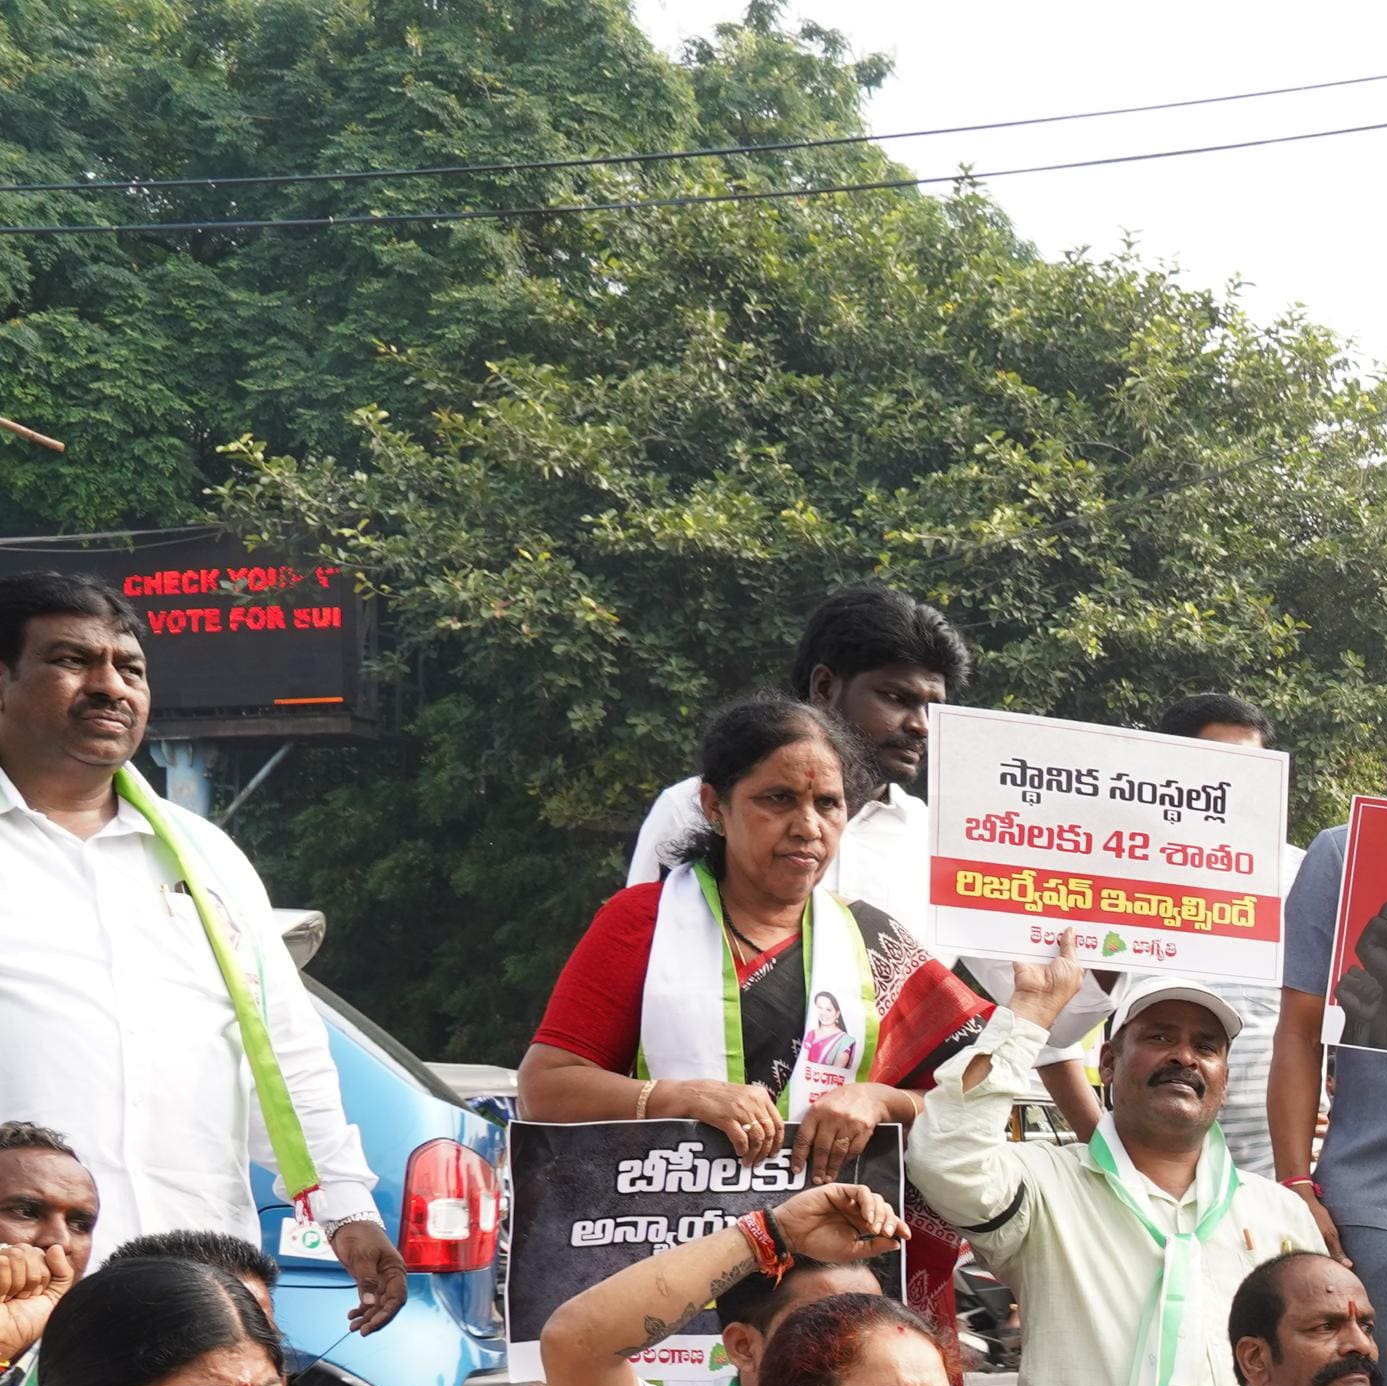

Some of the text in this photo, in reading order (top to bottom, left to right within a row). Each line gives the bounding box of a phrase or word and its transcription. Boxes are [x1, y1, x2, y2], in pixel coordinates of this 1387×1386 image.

[123, 568, 220, 597] CHECK
[147, 608, 223, 635] VOTE
[228, 605, 286, 631] FOR
[1000, 758, 1232, 825] స్థానిక సంస్థల్లో
[966, 811, 1254, 875] బీసీలకు 42 శాతం
[956, 870, 1258, 932] రిజర్వేషన్ ఇవ్వాల్సిందే
